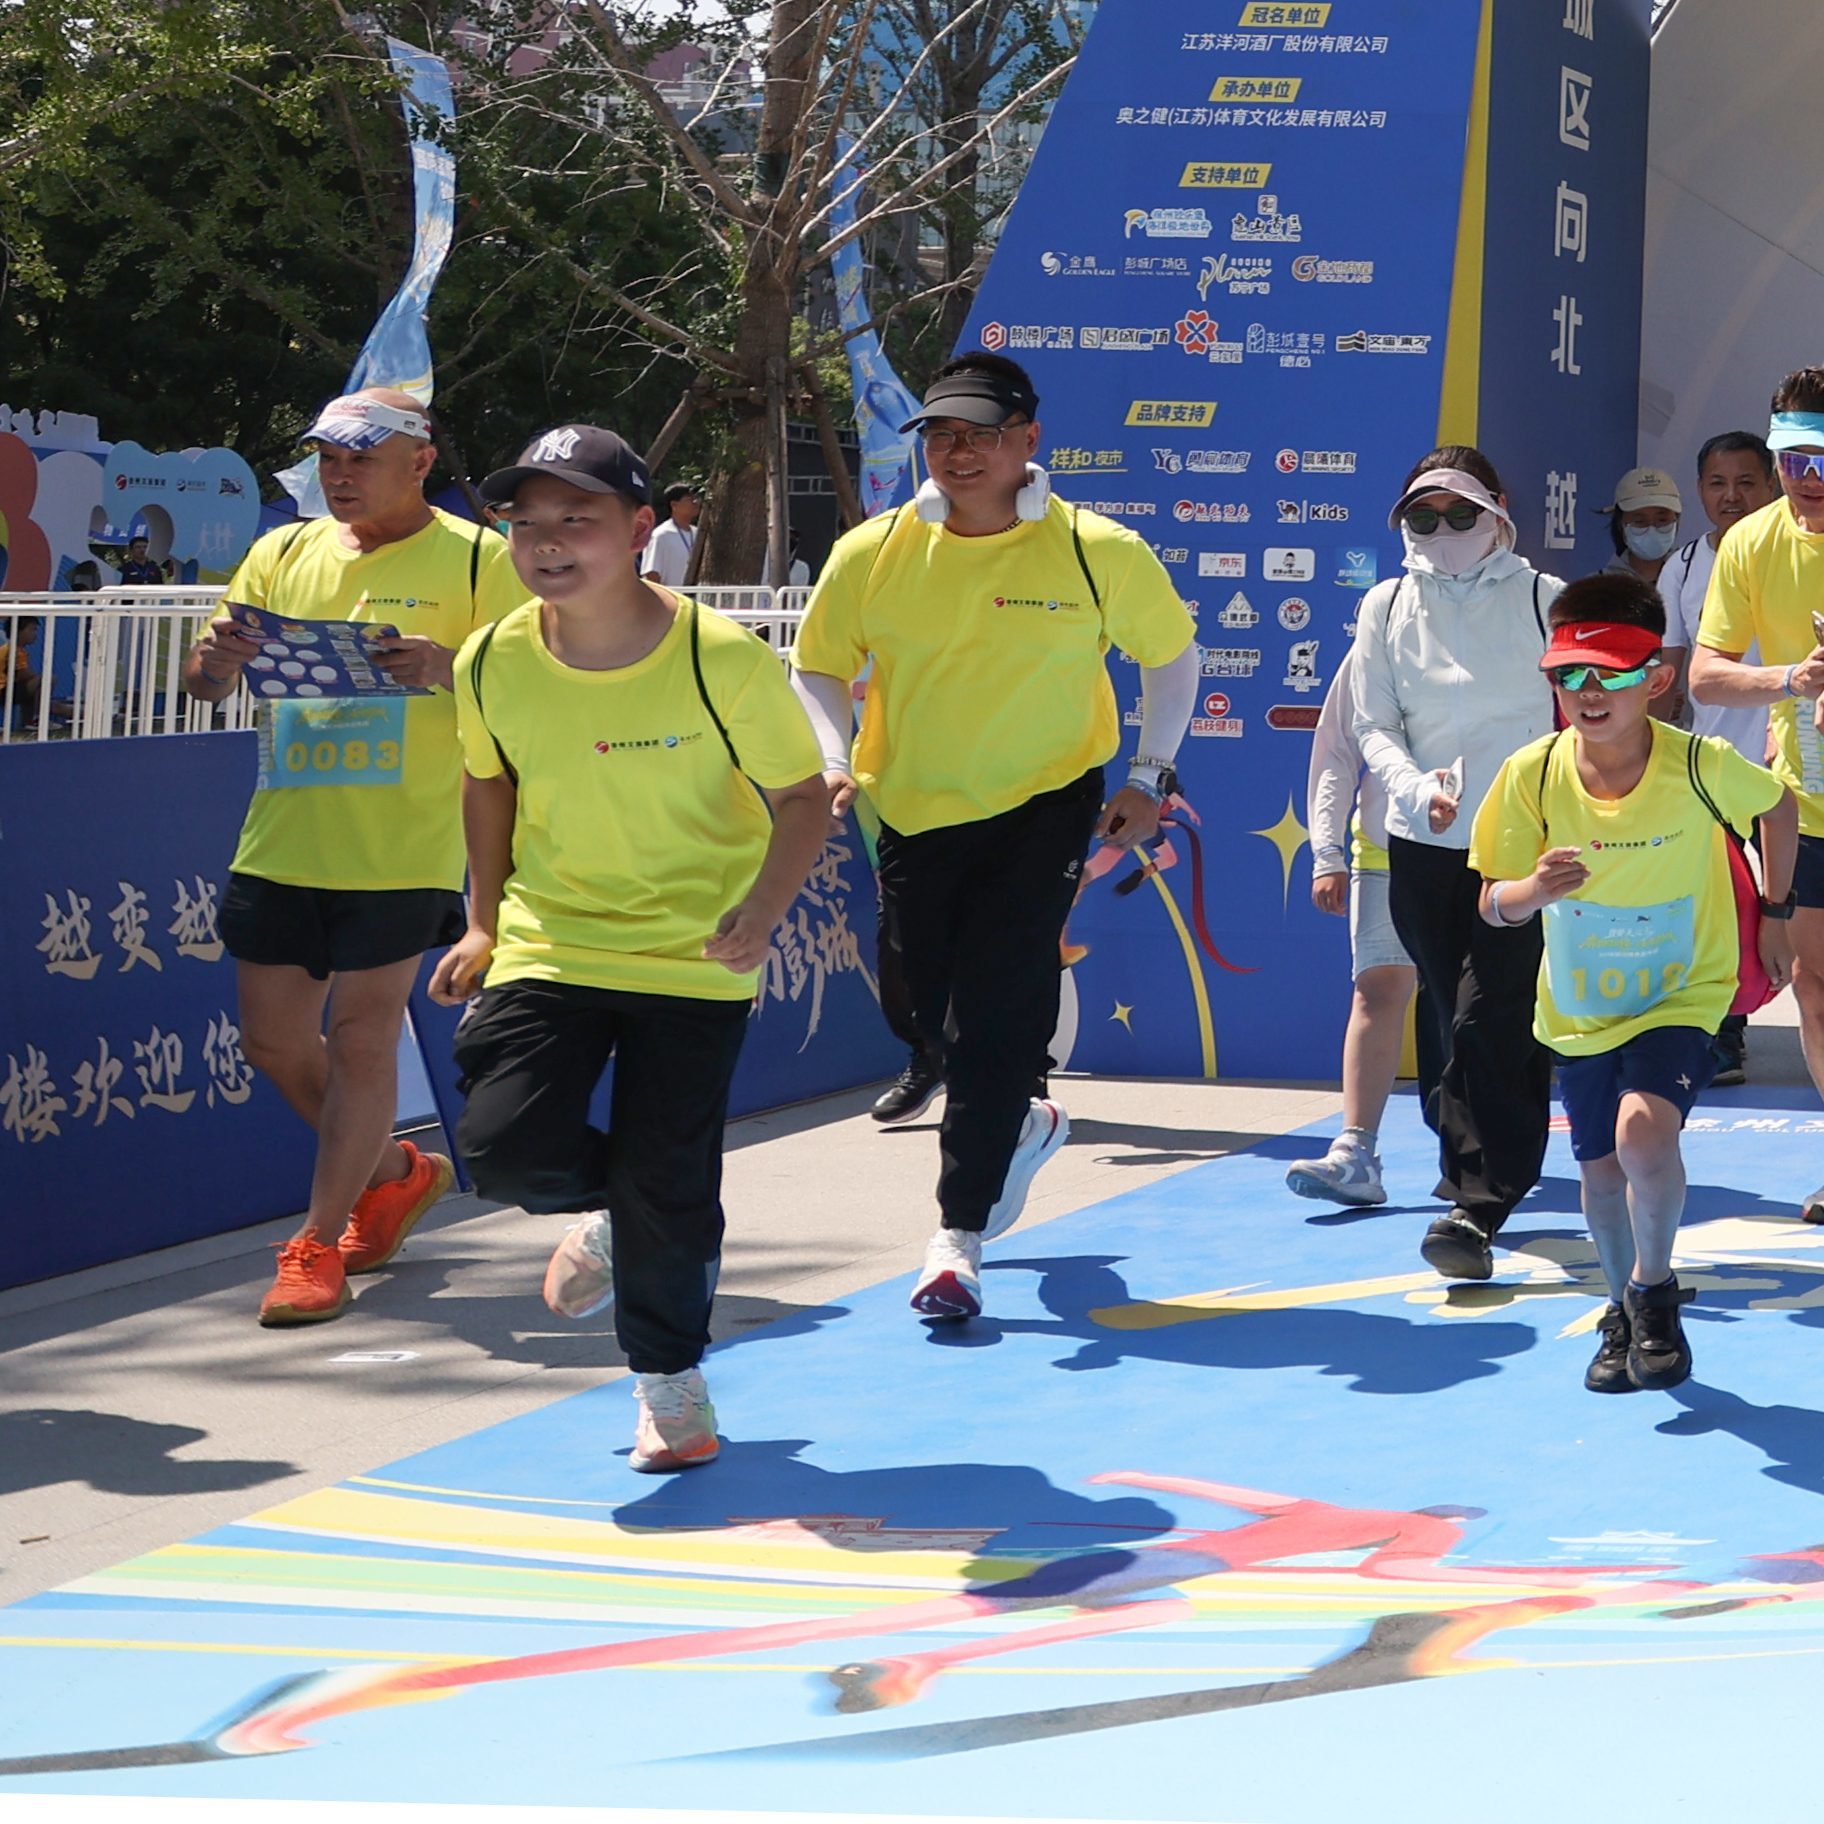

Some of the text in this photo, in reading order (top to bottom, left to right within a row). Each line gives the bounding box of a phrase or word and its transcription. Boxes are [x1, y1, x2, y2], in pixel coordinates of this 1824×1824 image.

[1250, 6, 1321, 25] 冠名单位
[1180, 33, 1389, 54] 江苏洋河酒厂股份有限公司
[1221, 80, 1291, 99] 承办单位
[1115, 106, 1387, 128] 奥之健(江苏)体育文化发展有限公司
[1190, 167, 1260, 185] 支持单位
[1124, 257, 1188, 271] 彭城广场店
[1010, 326, 1074, 342] 鼓楼广场
[1102, 328, 1171, 344] 君盛广场
[1266, 333, 1326, 349] 彭城壹号
[1136, 404, 1206, 422] 品牌支持
[1311, 504, 1348, 521] Kids
[1543, 471, 1578, 550] 越
[1219, 557, 1242, 568] 京东
[1207, 649, 1259, 660] 时代电影院线
[286, 740, 400, 772] 0083
[1, 1008, 255, 1146] 楼欢迎您
